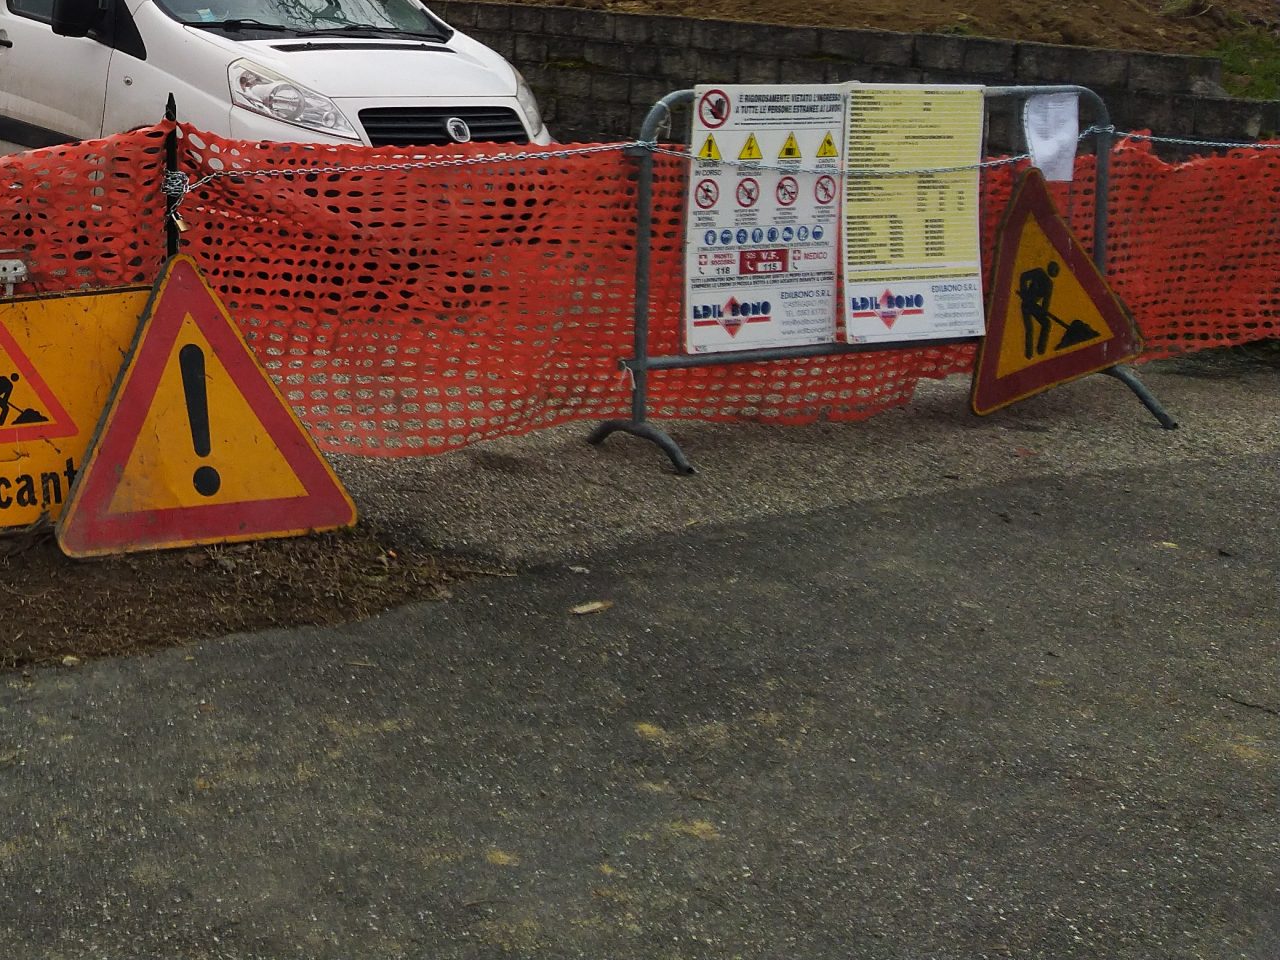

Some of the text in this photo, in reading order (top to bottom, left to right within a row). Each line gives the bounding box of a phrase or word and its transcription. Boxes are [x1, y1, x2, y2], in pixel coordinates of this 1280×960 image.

[744, 94, 790, 103] RIGOROSAMENTE
[791, 94, 812, 102] VIETATO
[813, 93, 841, 102] L'INGRESSO
[735, 106, 740, 114] A
[741, 106, 759, 114] TUTTE
[767, 105, 792, 114] PERSONE
[793, 105, 819, 113] ESTRANEE
[826, 104, 842, 113] LAVORI
[804, 252, 828, 260] MEDICO
[716, 267, 731, 275] 118
[763, 263, 777, 271] 115
[931, 284, 962, 293] EDILBONO
[780, 290, 814, 300] EDILBONO
[851, 296, 880, 311] EDIL
[887, 293, 924, 309] BONO
[693, 301, 771, 319] EDIL BONO
